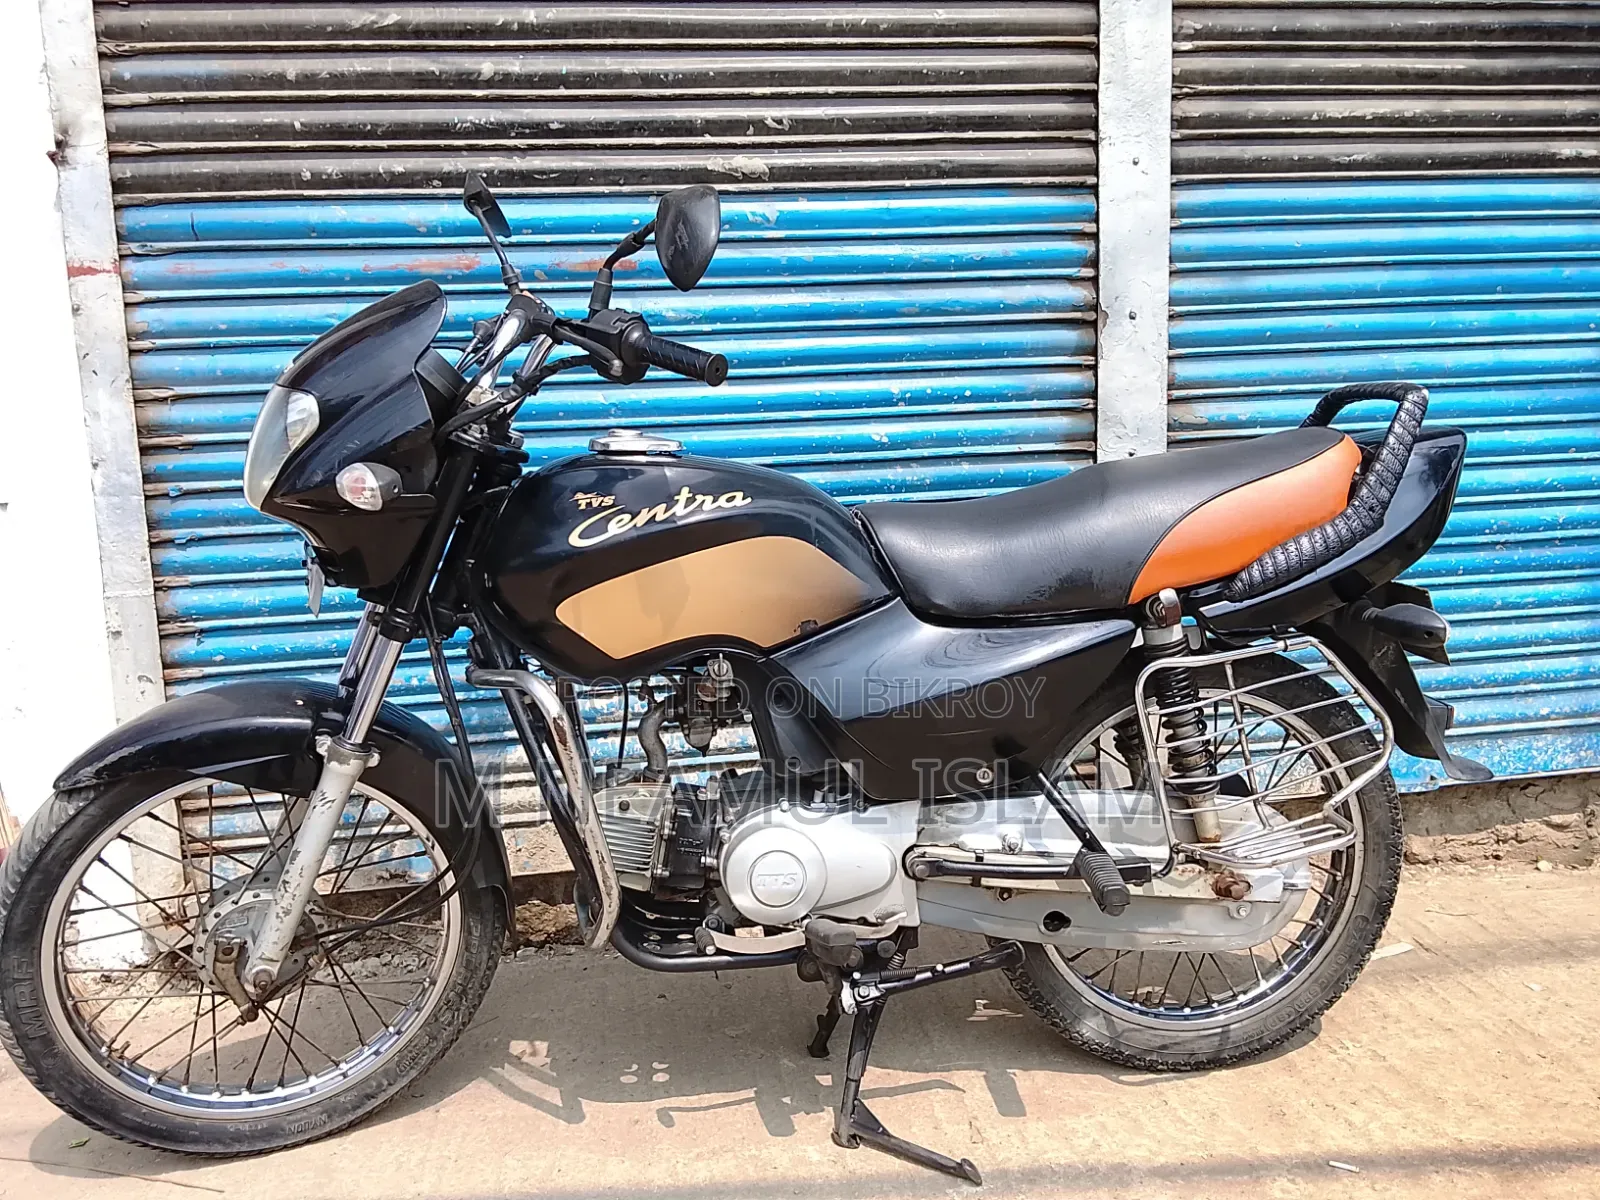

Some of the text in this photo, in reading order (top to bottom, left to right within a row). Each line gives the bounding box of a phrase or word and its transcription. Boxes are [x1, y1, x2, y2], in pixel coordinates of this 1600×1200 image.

[568, 486, 752, 547] Centra
[578, 495, 616, 510] TVS
[11, 955, 47, 1039] MRF
[286, 1113, 329, 1136] NYLON
